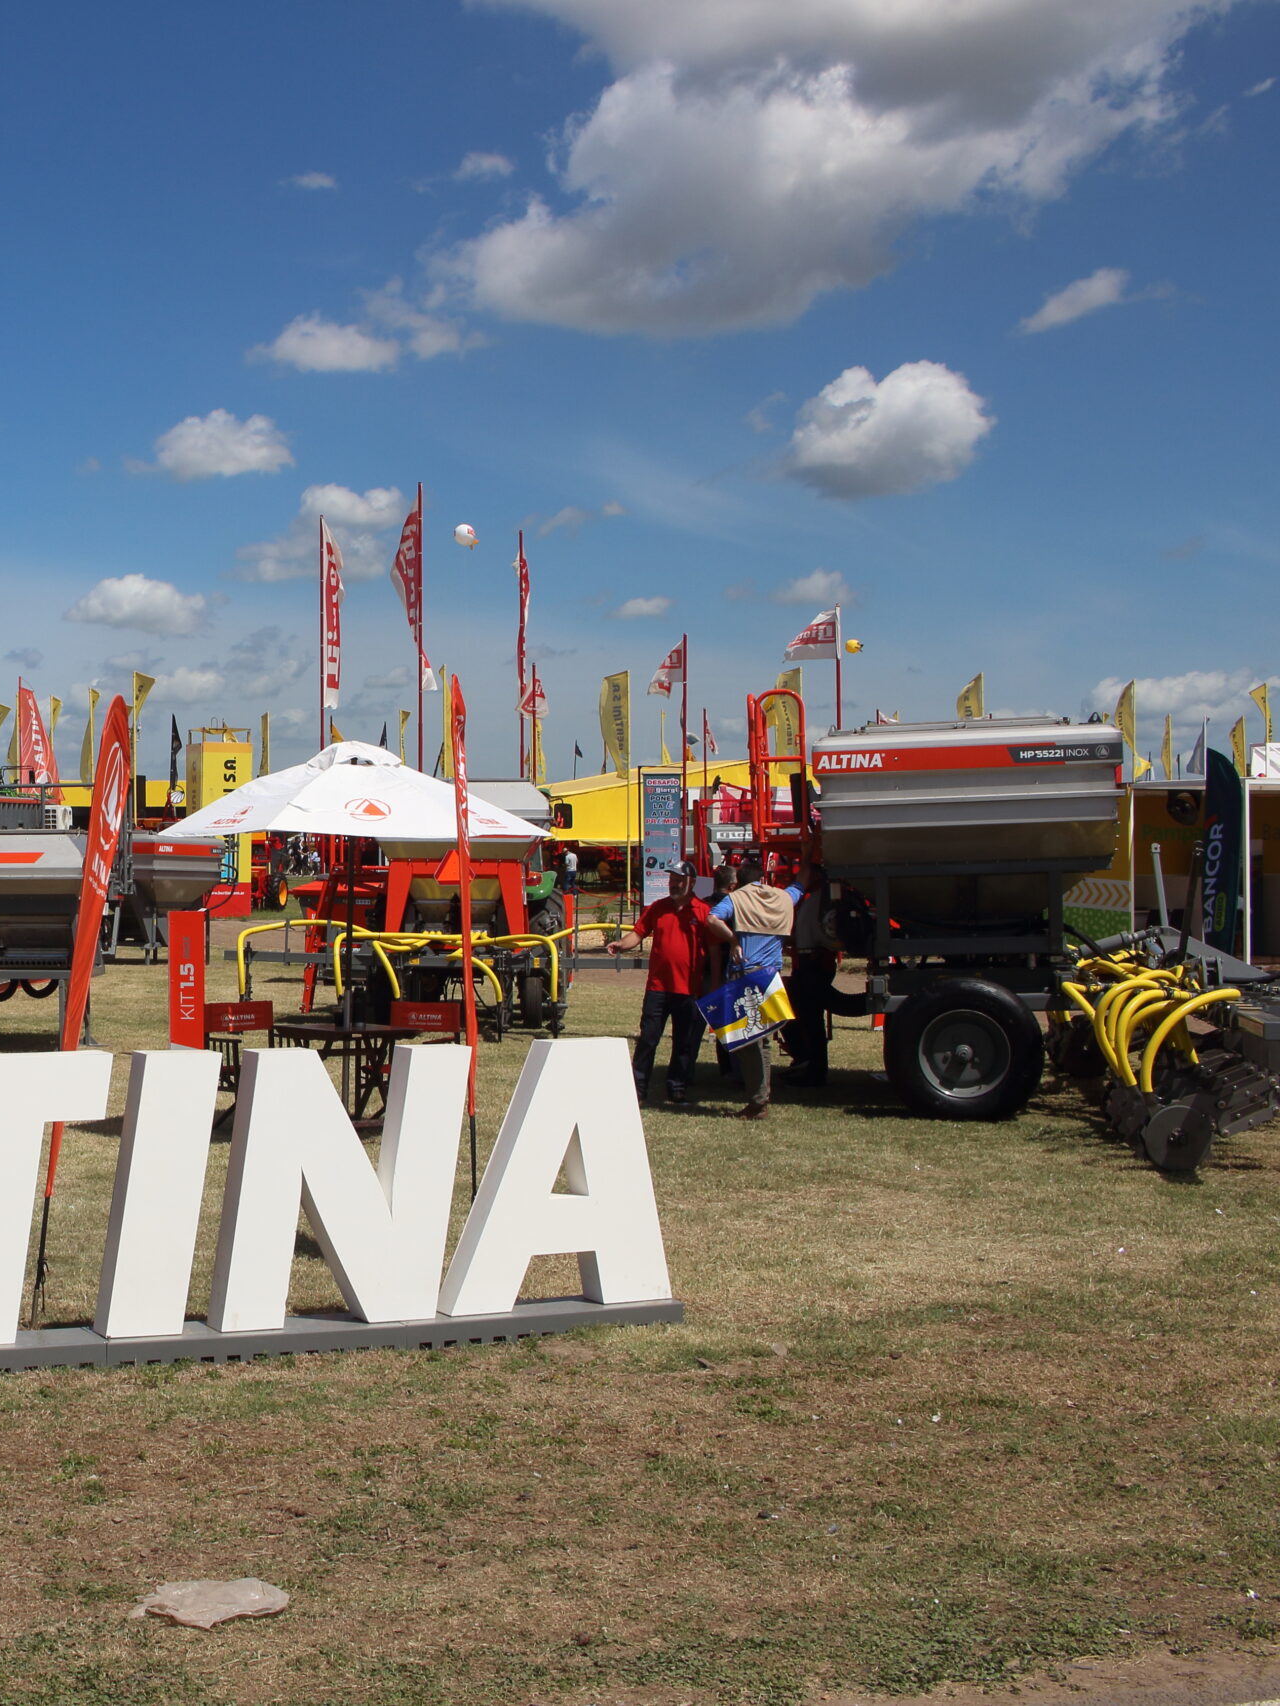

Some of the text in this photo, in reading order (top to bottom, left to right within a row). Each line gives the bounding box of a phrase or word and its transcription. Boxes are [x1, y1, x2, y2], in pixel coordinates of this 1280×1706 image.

[817, 753, 885, 770] ALTINA
[1066, 749, 1089, 757] INOX
[1204, 823, 1223, 932] BANCOR
